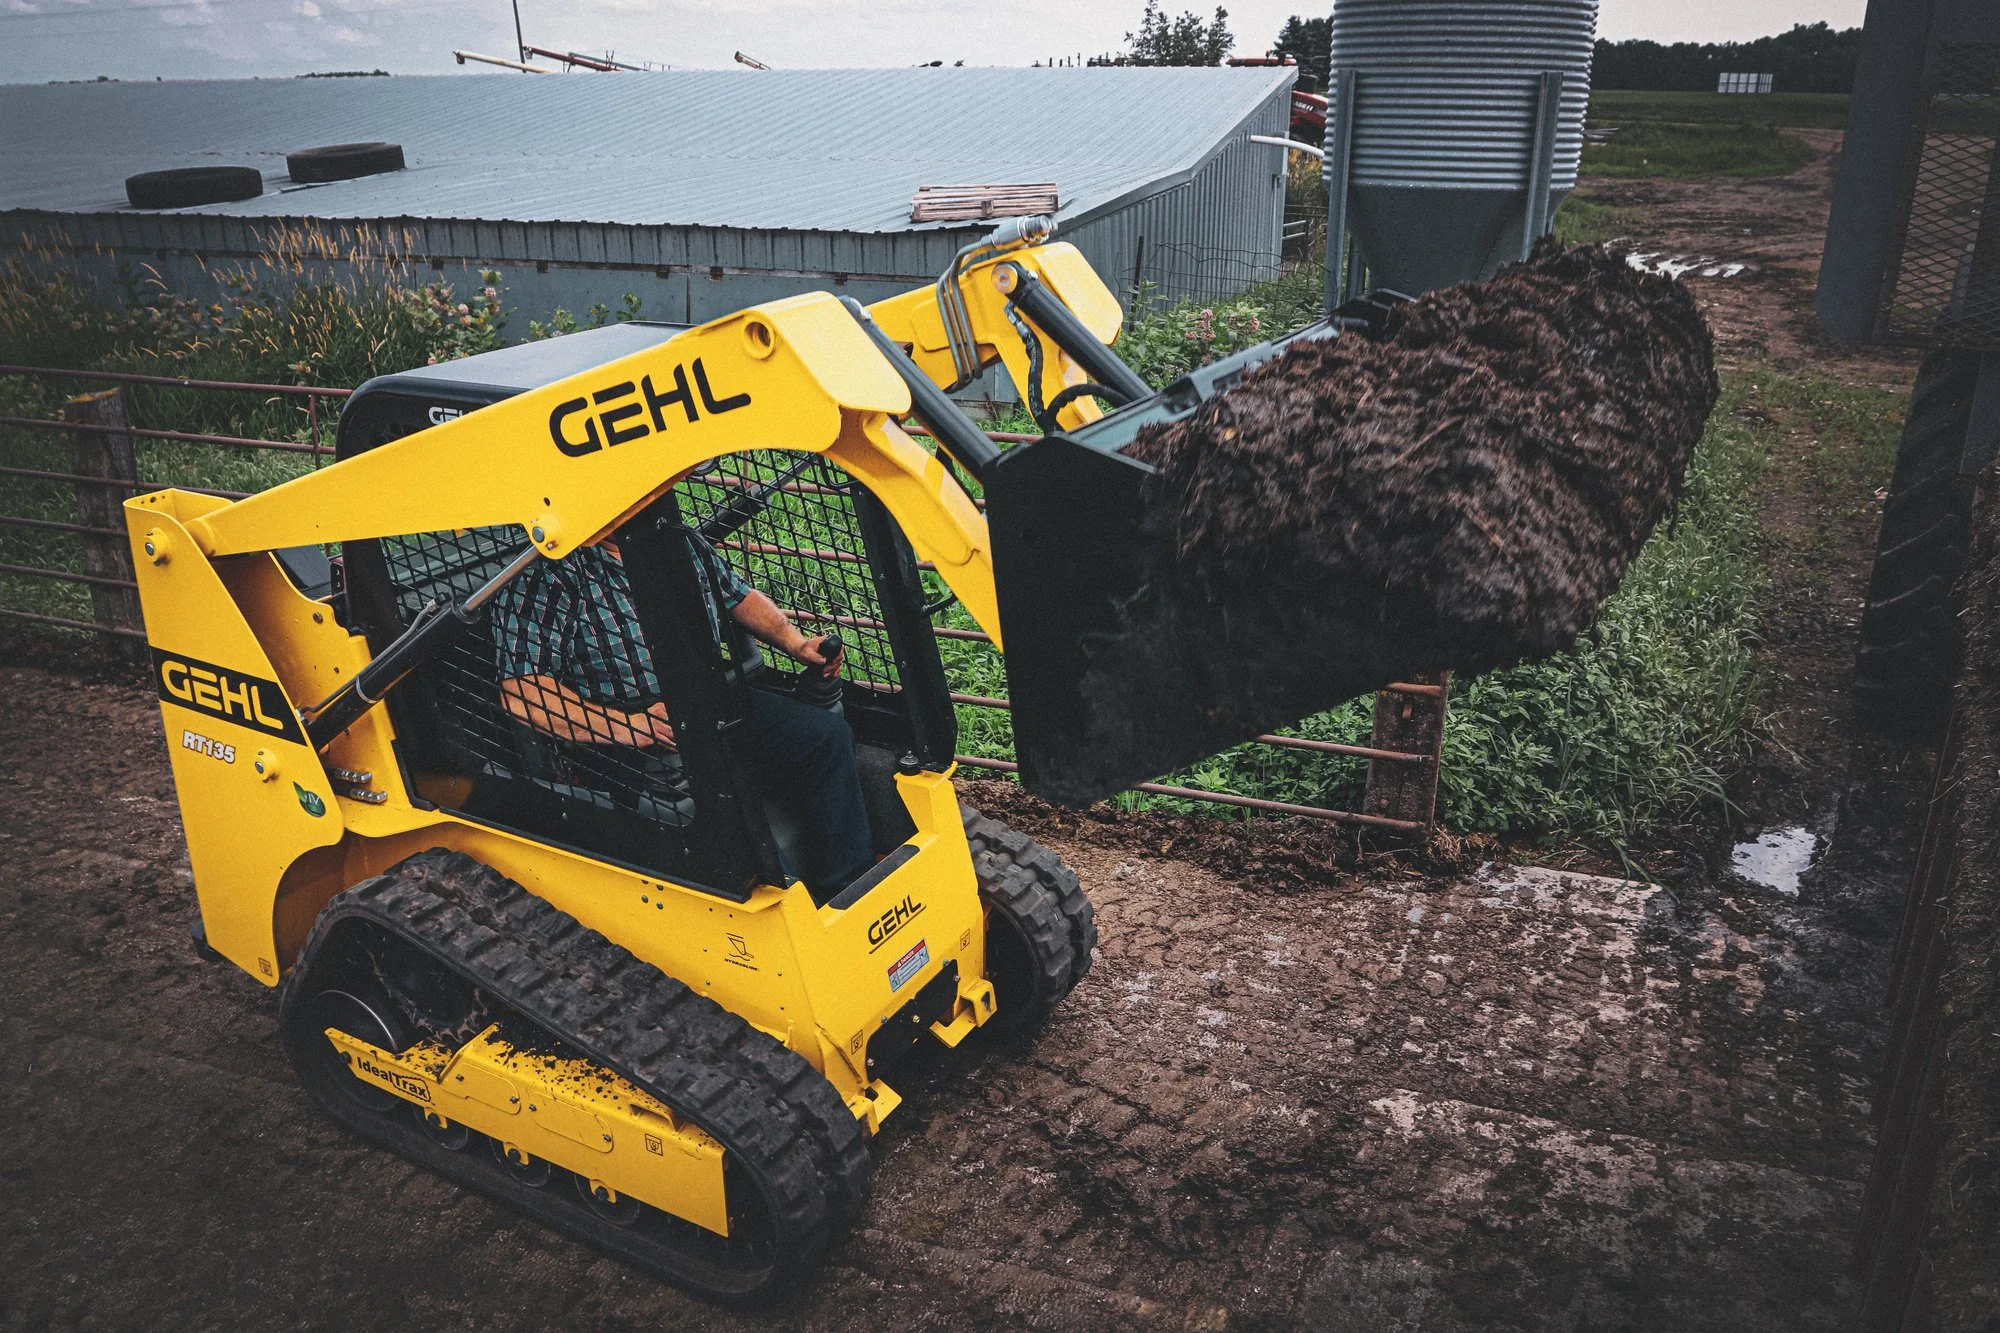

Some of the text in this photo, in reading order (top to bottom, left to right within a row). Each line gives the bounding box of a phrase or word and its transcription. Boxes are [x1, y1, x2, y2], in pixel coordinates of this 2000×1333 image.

[428, 406, 471, 425] GE
[549, 357, 752, 458] GEHL
[161, 660, 284, 730] GEHL
[182, 729, 236, 764] RT135
[868, 895, 922, 945] GEHL
[357, 1056, 428, 1099] IdealTrax
